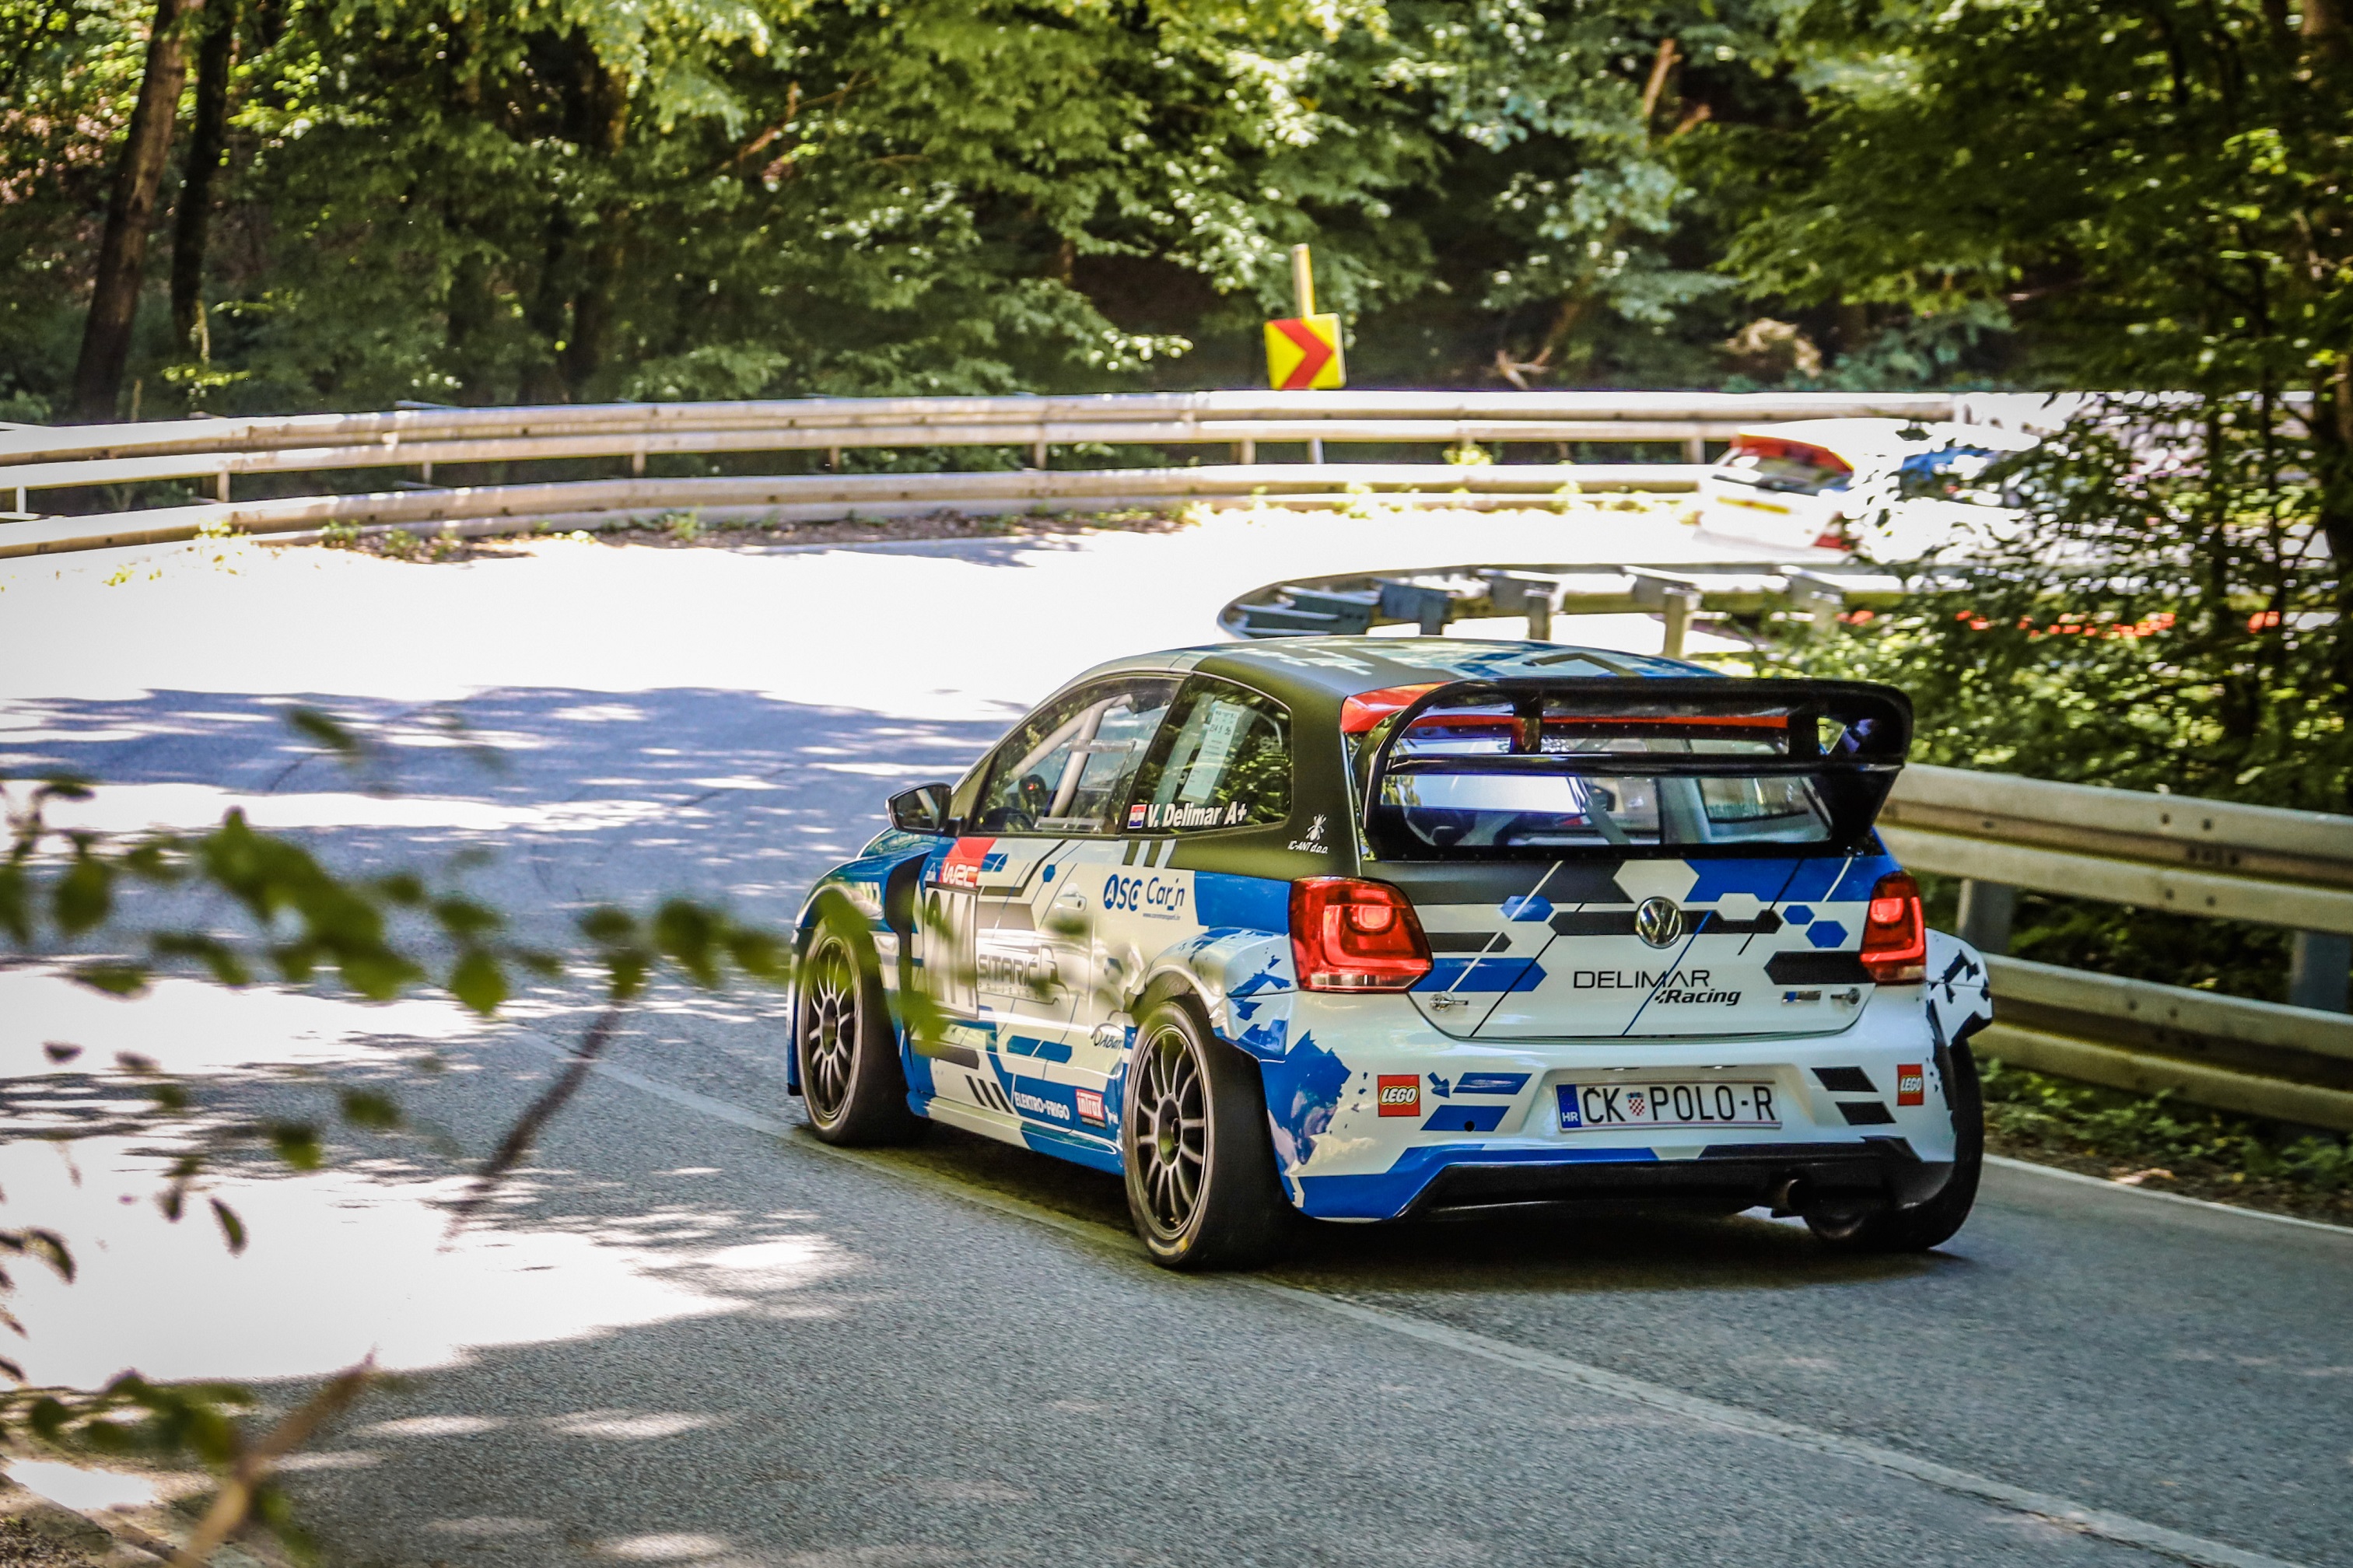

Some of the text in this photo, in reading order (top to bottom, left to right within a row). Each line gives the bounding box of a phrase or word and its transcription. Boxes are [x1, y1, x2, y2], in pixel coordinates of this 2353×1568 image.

[1147, 800, 1248, 828] V. Delimar A+
[941, 862, 979, 887] WRC
[1573, 969, 1711, 989] DELIMAR
[1664, 989, 1742, 1006] Racing
[1900, 1076, 1923, 1093] LEGO
[1380, 1087, 1418, 1104] LEGO
[1562, 1085, 1776, 1124] HR ČK POLO-R
